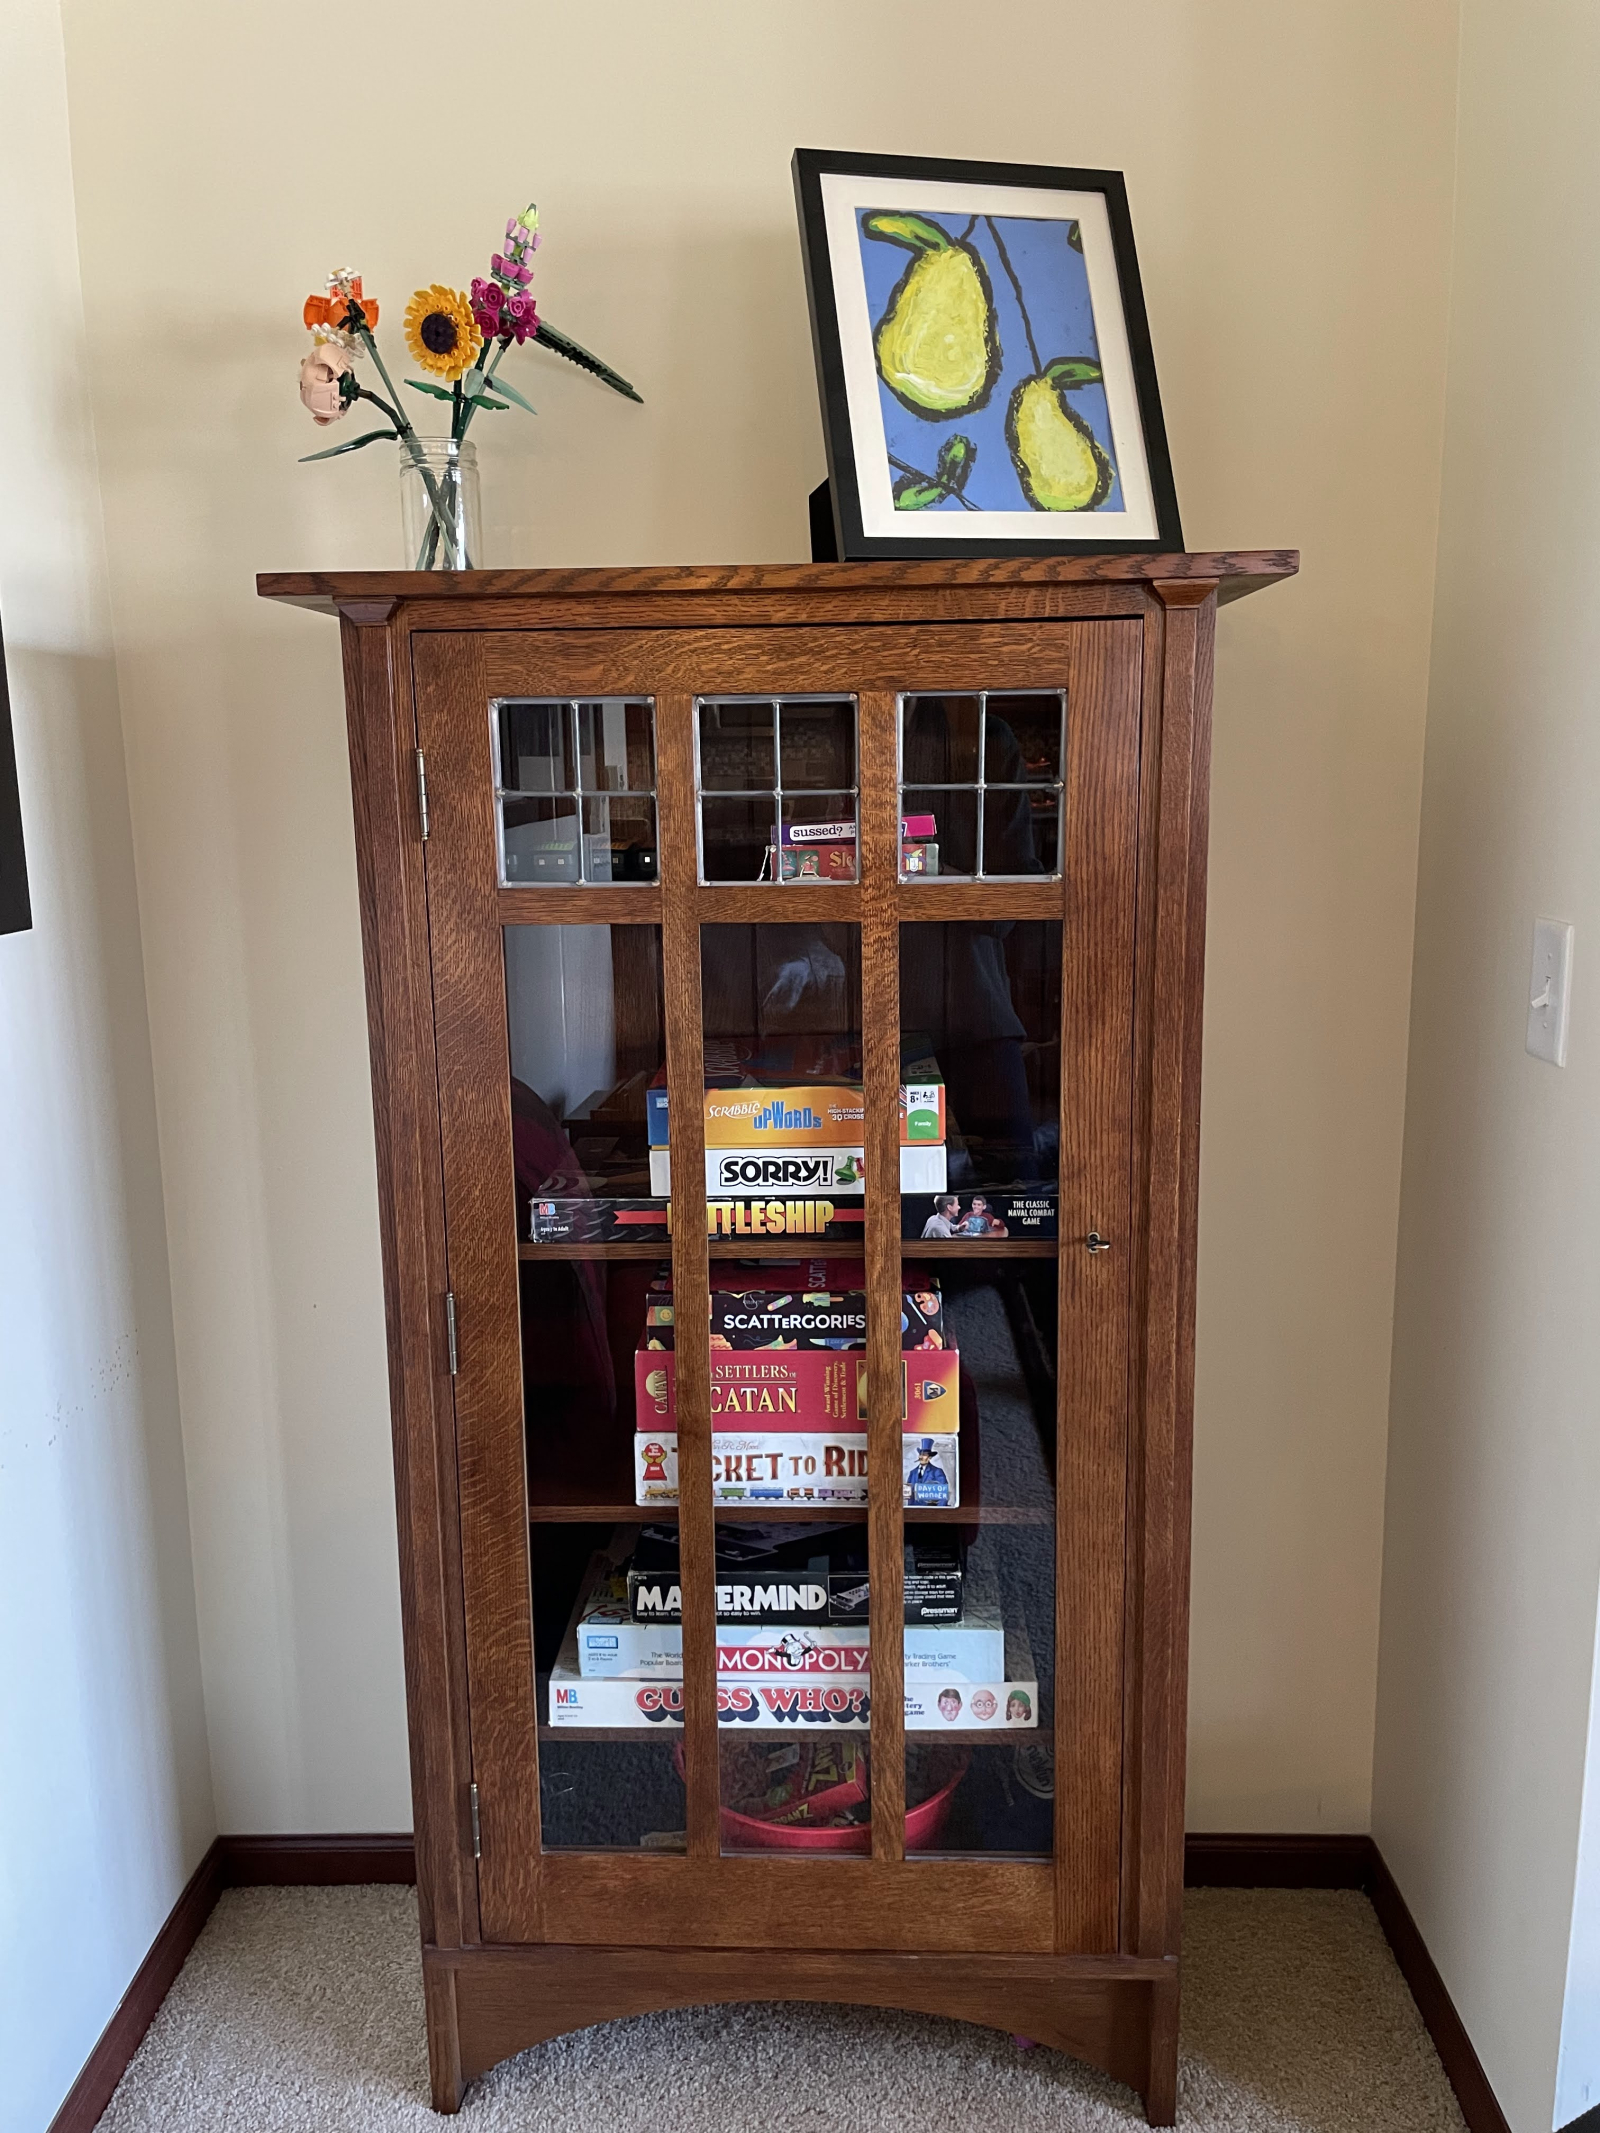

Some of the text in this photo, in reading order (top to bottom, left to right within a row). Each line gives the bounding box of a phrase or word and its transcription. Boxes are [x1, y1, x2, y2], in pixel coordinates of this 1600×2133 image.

[793, 825, 843, 838] sussed?
[723, 1159, 831, 1184] SORRY!
[1008, 1208, 1055, 1217] NAVAL COMBAT
[1013, 1200, 1050, 1208] THE CLASSIC
[1022, 1217, 1041, 1225] GAME
[723, 1314, 866, 1329] SCATTERGORIES
[716, 1364, 788, 1378] SETTLERS
[654, 1370, 668, 1414] CATAN
[711, 1386, 797, 1413] CATAN
[832, 1391, 838, 1399] of
[914, 1382, 922, 1400] 3061
[823, 1444, 868, 1477] RID
[637, 1585, 827, 1611] MAERMIND
[718, 1648, 869, 1671] MONOPOLY
[556, 1688, 577, 1704] MB
[759, 1686, 866, 1713] WHO?
